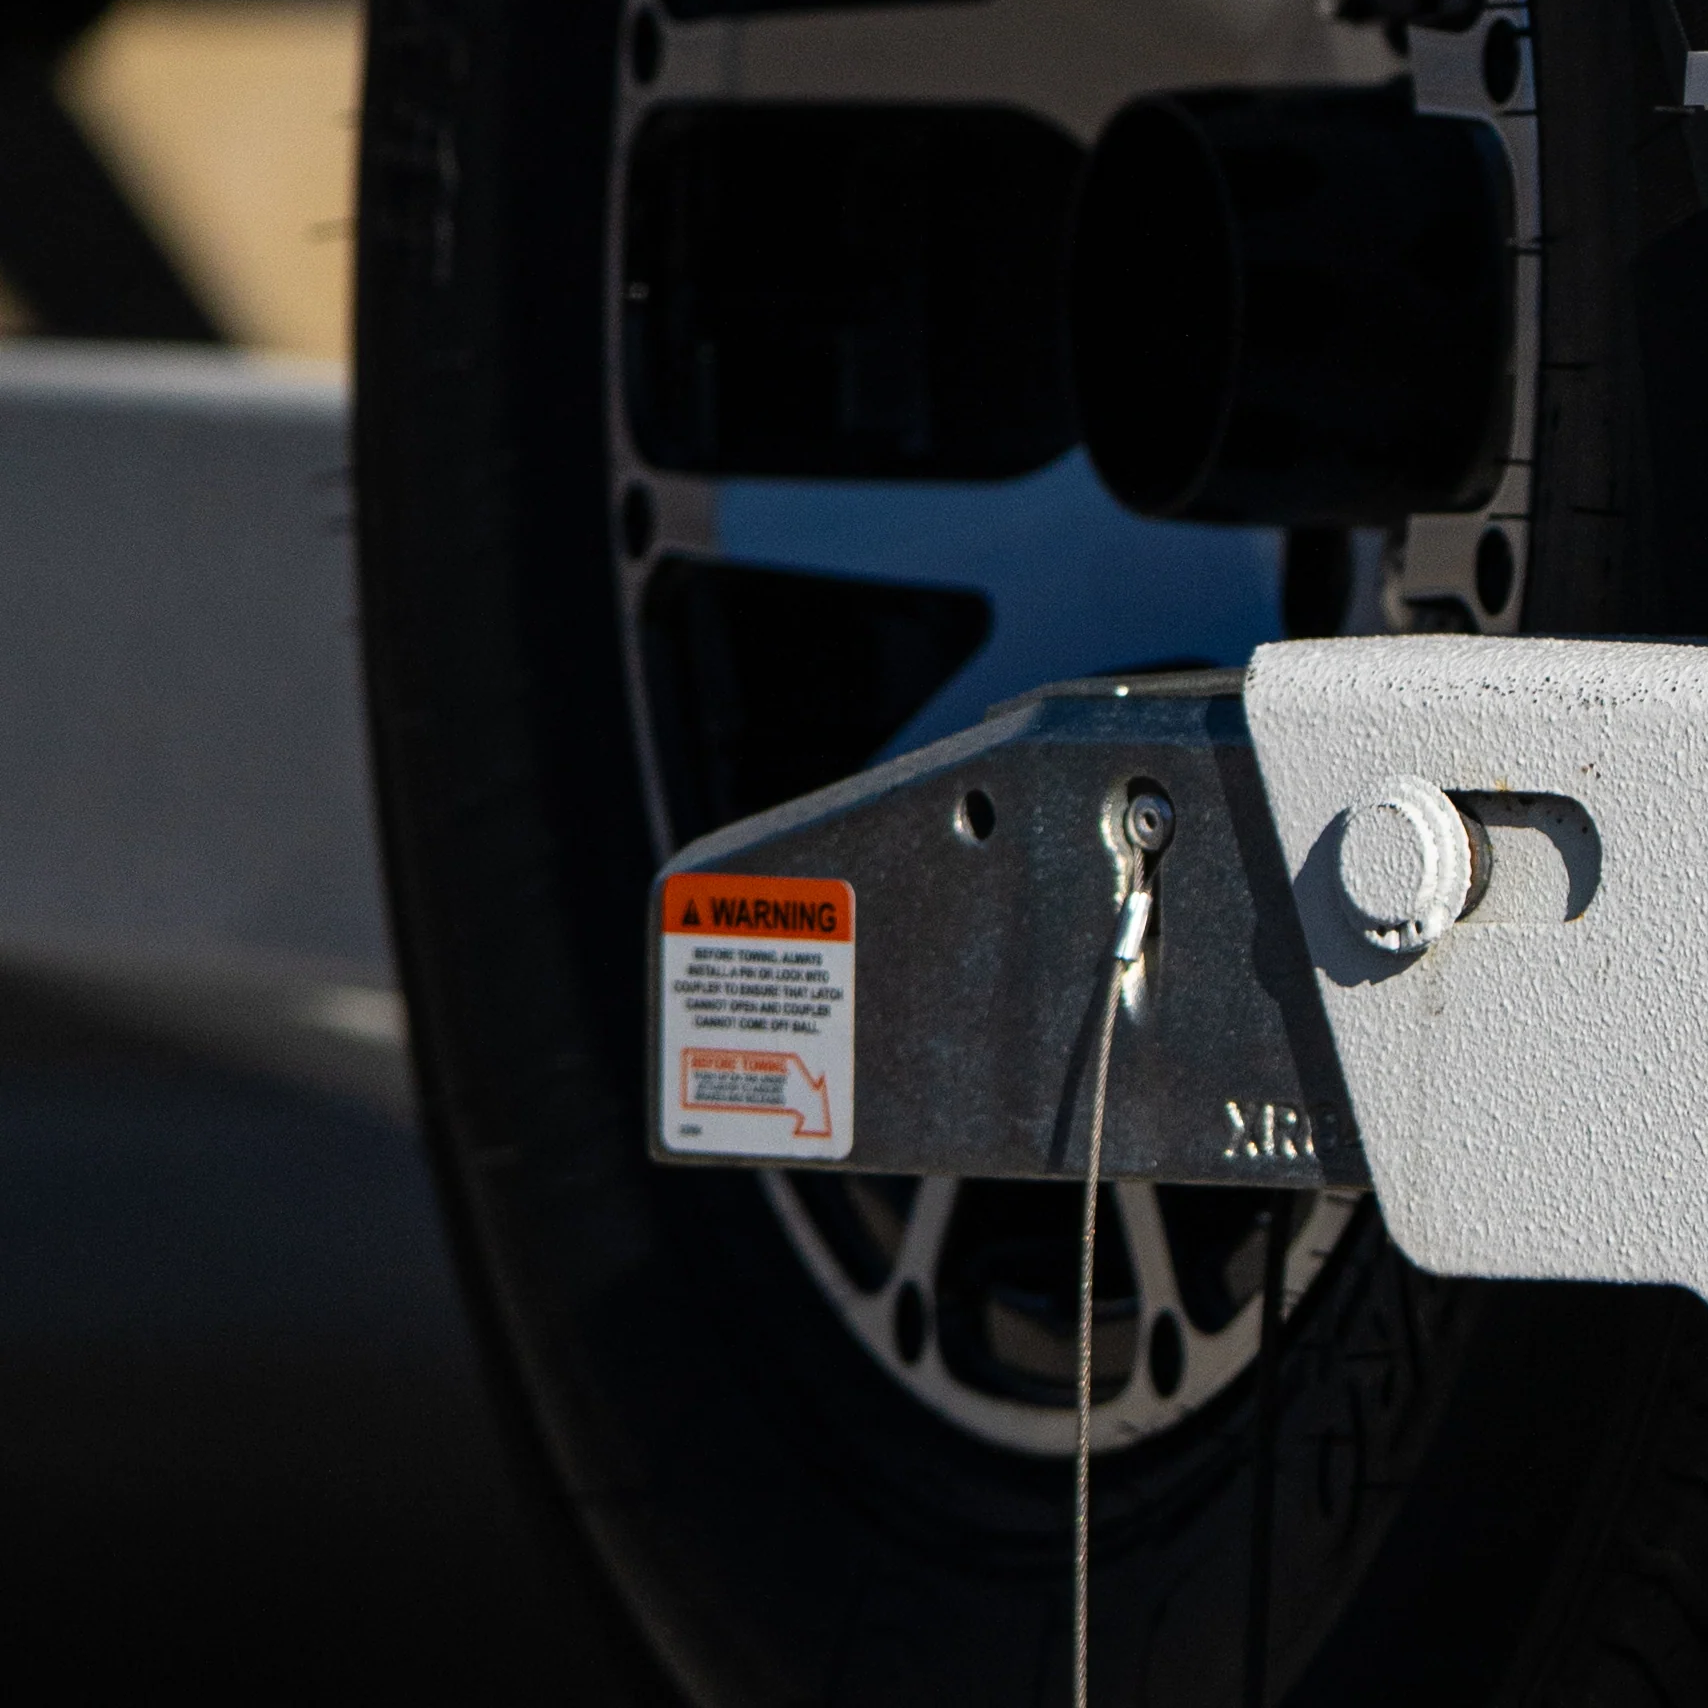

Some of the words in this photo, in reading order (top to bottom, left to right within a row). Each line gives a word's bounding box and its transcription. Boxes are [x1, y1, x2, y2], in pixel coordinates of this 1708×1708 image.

[711, 896, 836, 932] WARNING
[694, 947, 733, 961] BEFORE
[782, 952, 822, 965] ALWAYS
[784, 986, 808, 998] THAT
